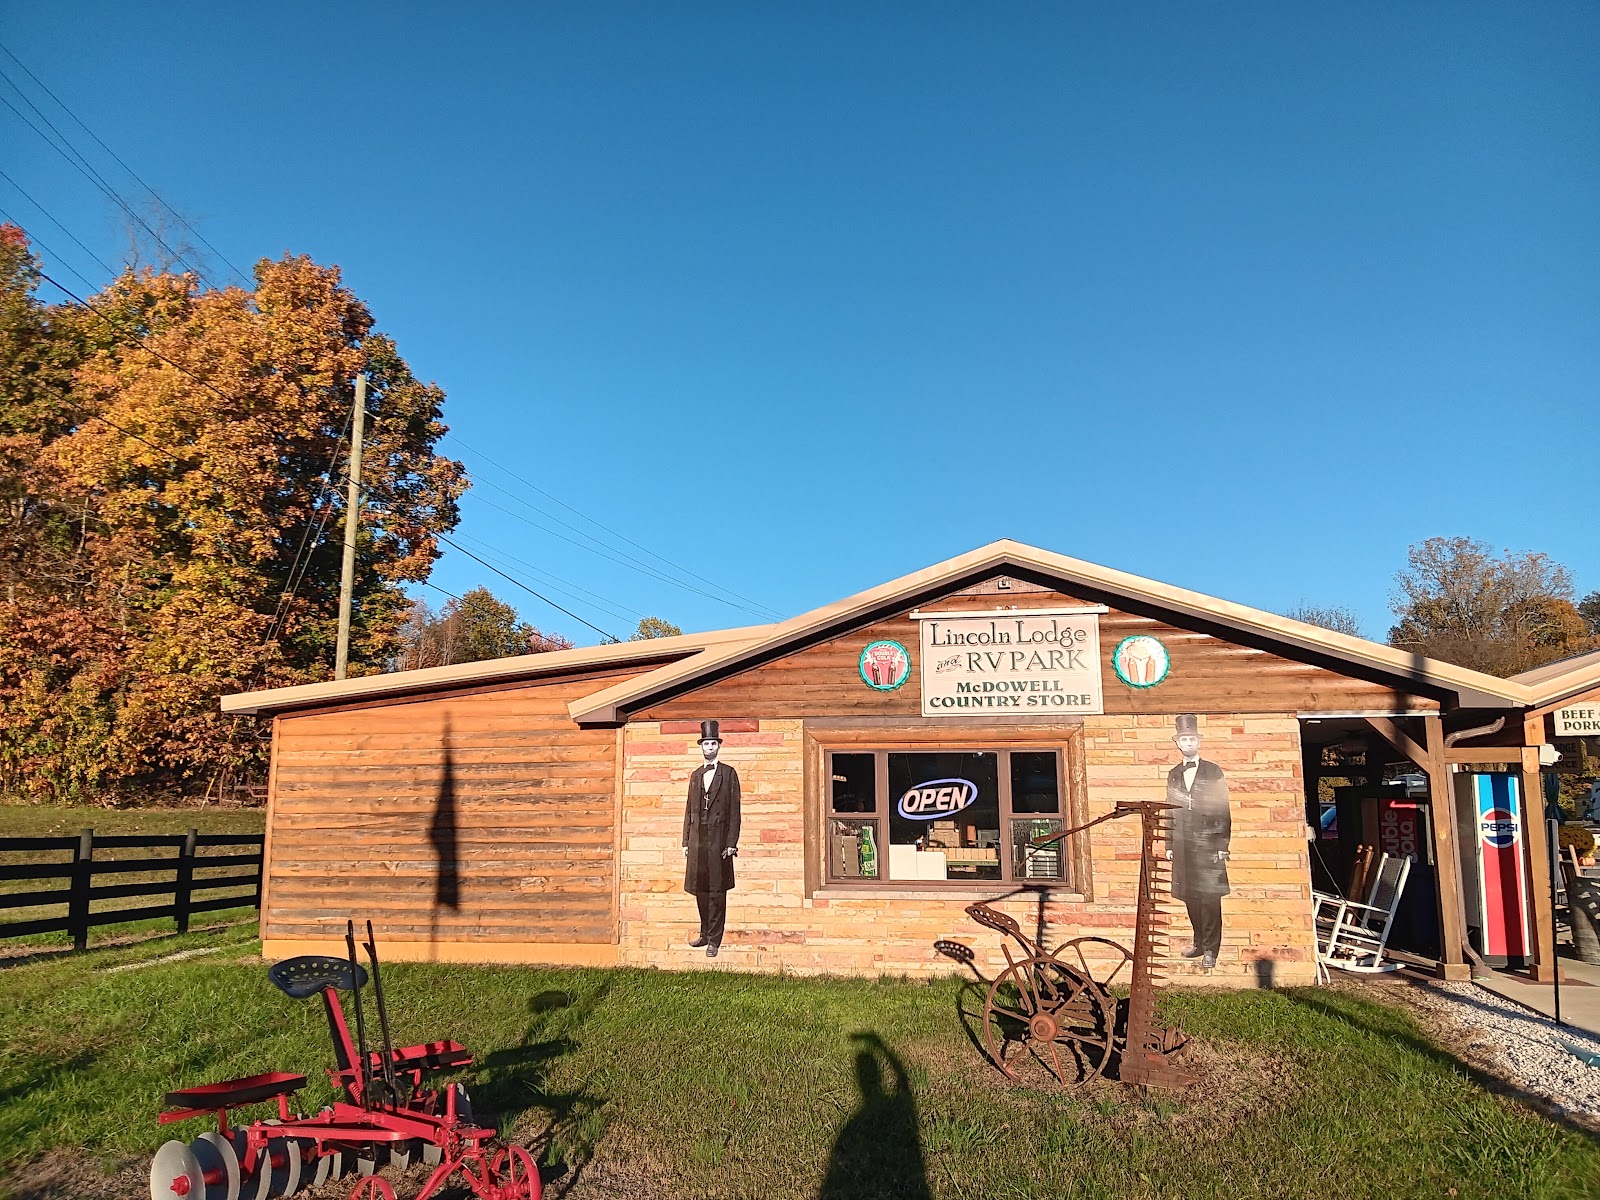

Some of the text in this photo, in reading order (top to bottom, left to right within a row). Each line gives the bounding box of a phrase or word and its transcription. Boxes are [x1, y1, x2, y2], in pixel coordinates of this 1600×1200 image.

[930, 619, 1088, 648] Lincoln Lodge
[936, 649, 1089, 673] and RV PARK
[956, 680, 1064, 694] McDOWELL
[929, 694, 1091, 708] COUNTRY STORE
[1561, 709, 1595, 719] BEEF
[903, 785, 968, 813] OPEN
[1481, 823, 1518, 832] PEPSI
